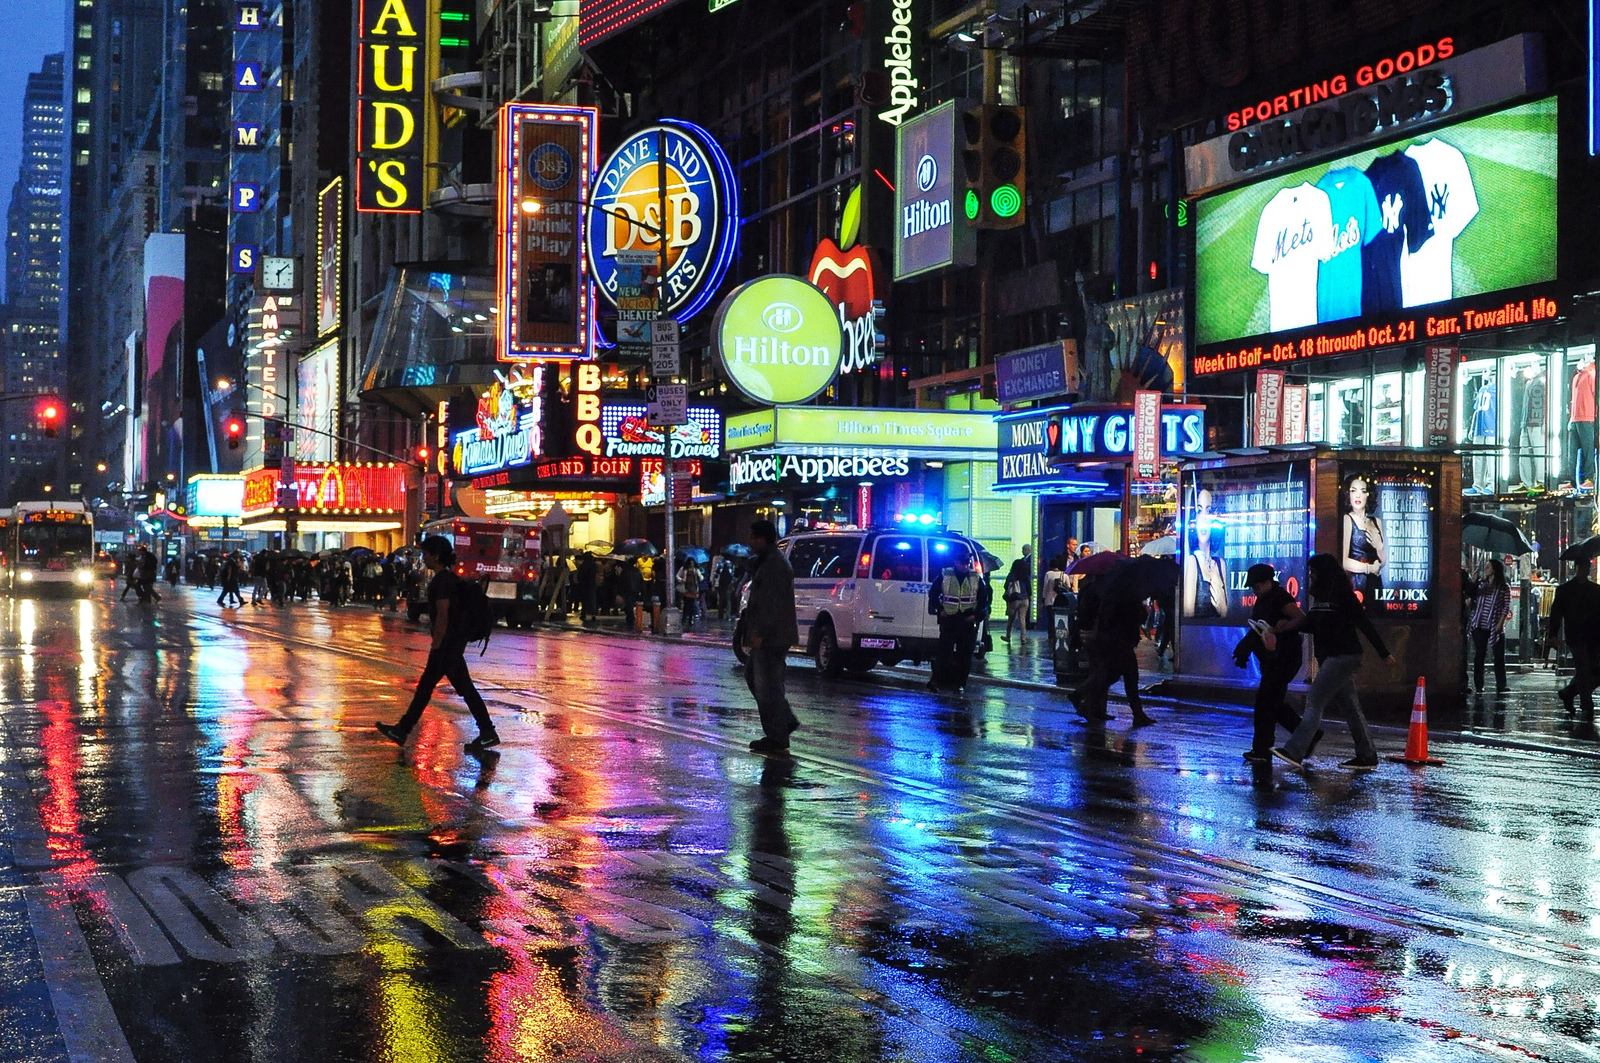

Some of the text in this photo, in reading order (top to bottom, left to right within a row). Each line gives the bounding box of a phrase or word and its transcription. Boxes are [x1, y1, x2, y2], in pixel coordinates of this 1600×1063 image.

[1227, 76, 1348, 131] SPORTING
[1355, 38, 1455, 86] GOODS
[602, 137, 650, 193] DAVE
[602, 190, 702, 257] D&B
[903, 199, 950, 239] Hilton
[527, 235, 572, 256] Play
[1272, 218, 1314, 264] Mets
[619, 286, 641, 296] NEW
[618, 309, 658, 320] THEATER
[656, 322, 673, 331] BUS
[1194, 357, 1225, 375] Week
[1227, 354, 1237, 369] in
[1239, 348, 1262, 367] Golf
[1273, 342, 1297, 362] Oct.
[1300, 338, 1314, 358] 18
[1317, 329, 1365, 355] through
[1368, 324, 1395, 346] Oct.
[1399, 320, 1416, 342] 21
[1532, 298, 1557, 320] Mo
[655, 333, 675, 343] LANE
[734, 336, 830, 366] Hilton
[1011, 353, 1048, 374] MONEY
[658, 386, 684, 395] BUSES
[1004, 371, 1060, 396] EXCHANGE
[1428, 347, 1438, 430] SPORTING GOODS
[1435, 347, 1453, 431] MODELL'S
[576, 364, 601, 455] BBQ
[1264, 374, 1280, 446] MODELL'S
[837, 421, 880, 434] Hilton
[884, 422, 924, 435] Times
[1062, 415, 1099, 454] NY
[1103, 415, 1202, 454] GITS
[1144, 393, 1156, 461] MODELL'S
[592, 461, 630, 474] JOIN
[642, 461, 662, 474] US
[780, 455, 909, 483] Applebees
[1382, 500, 1399, 512] LOVE
[1386, 521, 1428, 537] SCANDAL
[1389, 547, 1428, 562] CHILD STAR
[476, 563, 513, 573] Dunbar
[1389, 569, 1428, 581] PAPARAZZI
[1230, 572, 1250, 590] LIZ
[1374, 589, 1394, 600] LIZ
[1399, 589, 1428, 600] DICK
